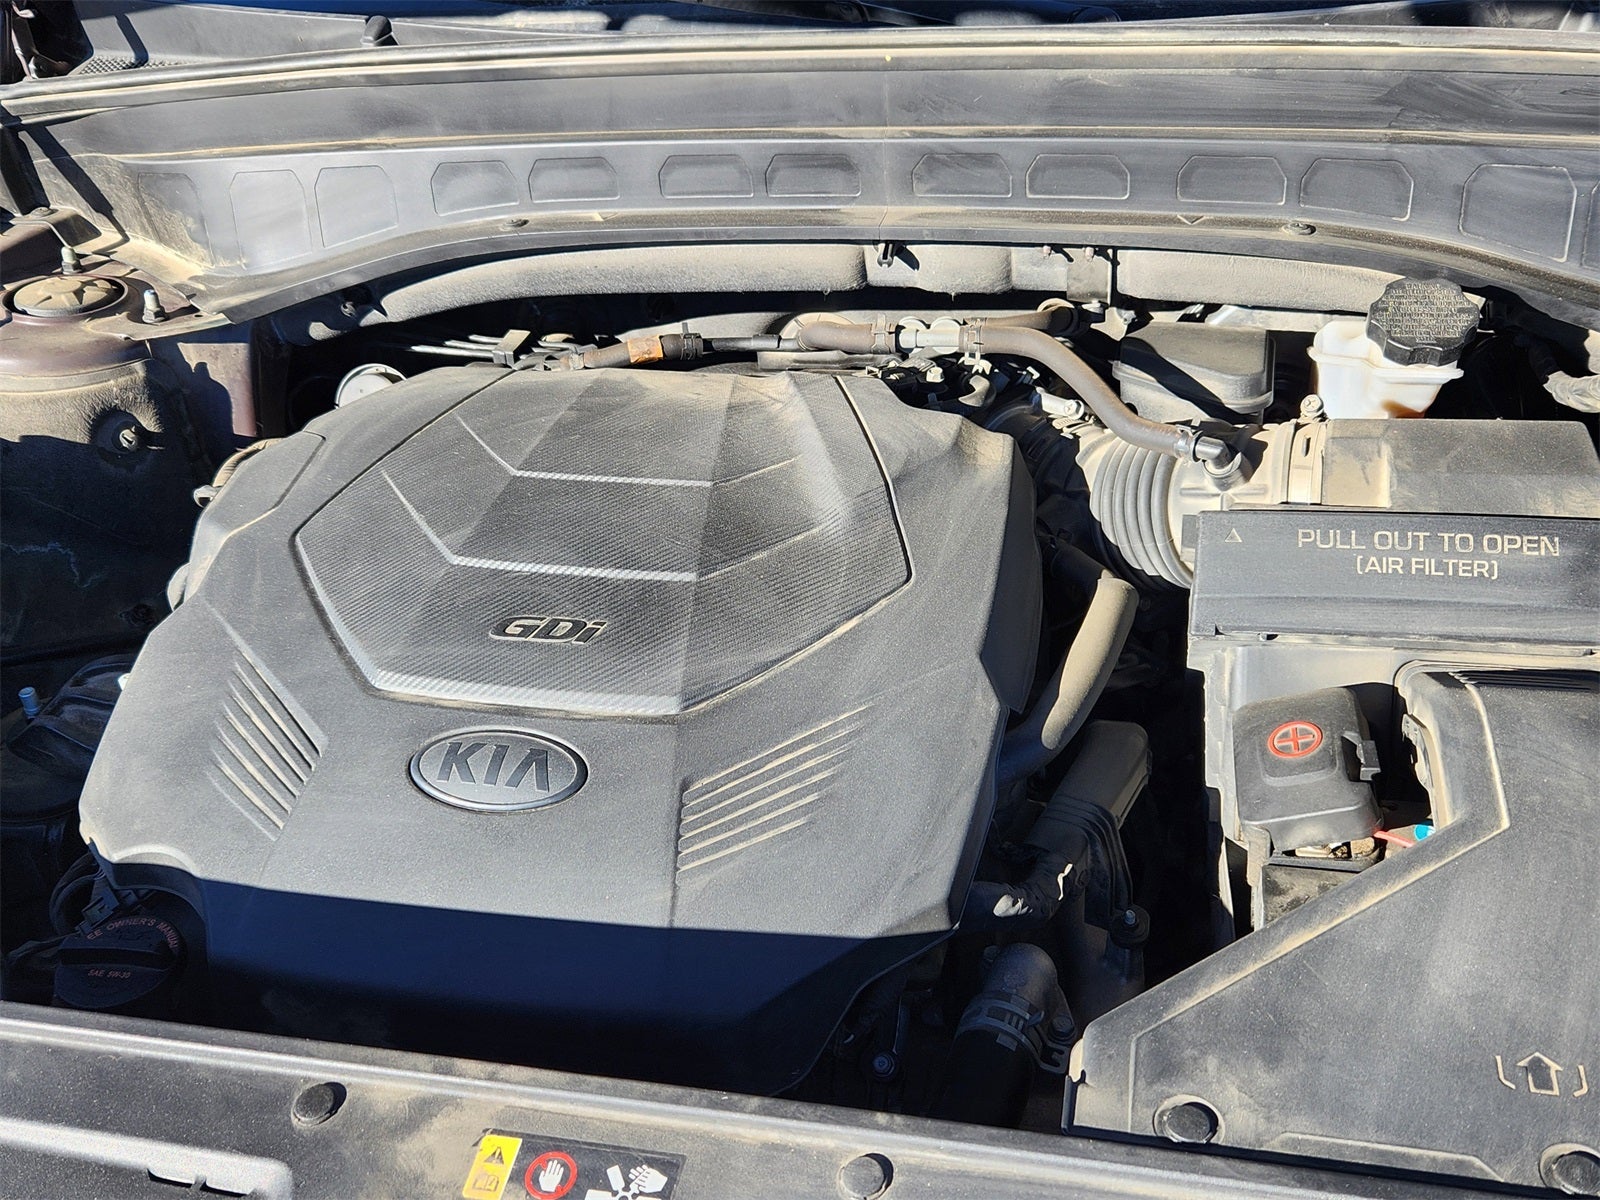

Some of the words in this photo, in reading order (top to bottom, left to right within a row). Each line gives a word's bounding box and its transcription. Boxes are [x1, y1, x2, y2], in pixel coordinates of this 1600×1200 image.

[1297, 529, 1366, 550] PULL
[1373, 530, 1430, 551] OUT
[1438, 532, 1473, 553] TO
[1482, 533, 1560, 557] OPEN
[489, 615, 607, 644] GDi
[436, 741, 550, 793] KIA
[87, 929, 103, 940] EE
[107, 918, 156, 930] OWNER'S
[88, 969, 106, 978] SAE
[107, 970, 131, 979] 5W-30
